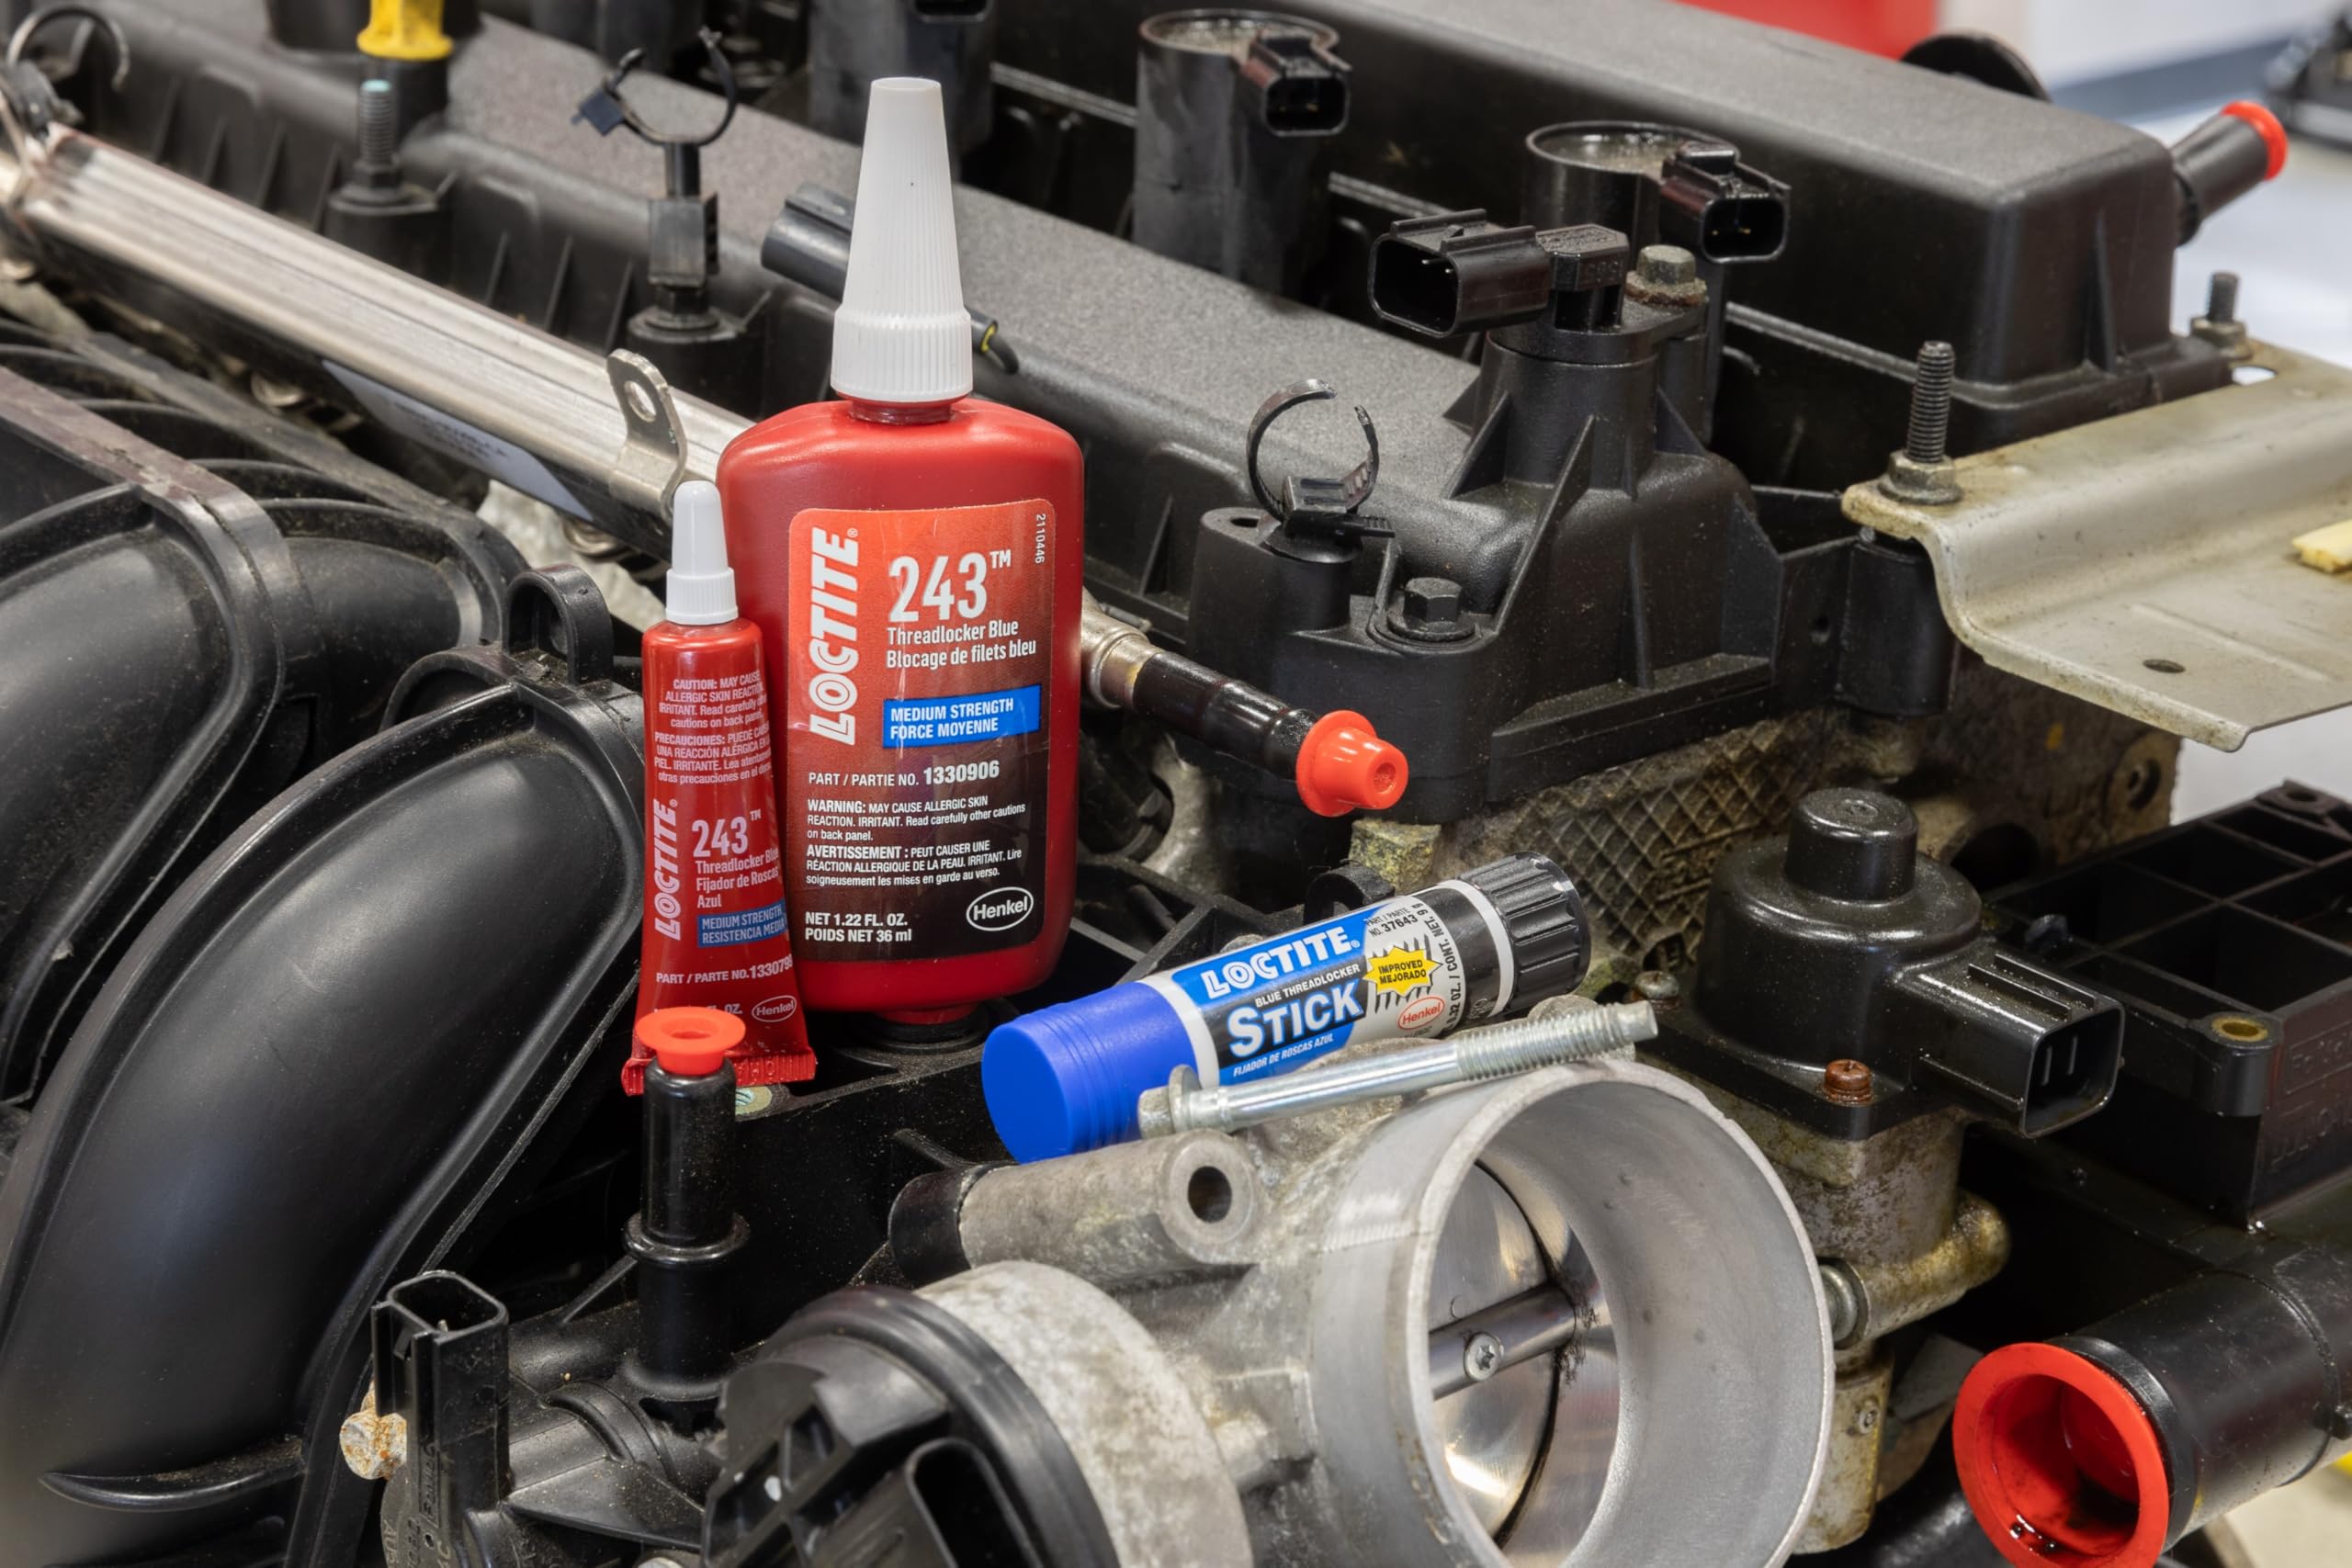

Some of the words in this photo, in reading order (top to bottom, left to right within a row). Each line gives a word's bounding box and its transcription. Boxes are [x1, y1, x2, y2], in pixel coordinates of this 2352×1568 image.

[1035, 513, 1046, 564] 2110446
[887, 626, 986, 646] Threadlocker
[989, 621, 1018, 637] Blue
[887, 648, 947, 670] Blocage
[951, 648, 967, 664] de
[971, 644, 1006, 663] filets
[1009, 639, 1036, 657] bleu
[673, 679, 717, 690] CAUTION:
[720, 676, 738, 689] MAY
[740, 670, 761, 685] CAUSE
[665, 692, 707, 703] ALLERGIC
[709, 692, 730, 702] SKIN
[659, 703, 697, 715] IRRITANT.
[700, 705, 722, 715] Read
[725, 700, 756, 714] carefully
[891, 705, 946, 722] MEDIUM
[950, 698, 1013, 718] STRENGTH
[671, 718, 707, 728] cautions
[710, 718, 721, 727] on
[724, 715, 743, 727] back
[890, 724, 933, 739] FORCE
[938, 718, 998, 736] MOYENNE
[655, 731, 725, 746] PRECAUCIONES:
[728, 729, 752, 743] PUEDE
[657, 746, 673, 756] UNA
[674, 746, 719, 758] REACCIÓN
[673, 761, 721, 771] IRRITANTE.
[724, 758, 740, 769] Lea
[808, 773, 840, 785] PART
[842, 773, 849, 785] /
[852, 773, 895, 786] PARTIE
[899, 773, 919, 785] NO.
[923, 761, 1000, 784] 1330906
[659, 773, 678, 783] otras
[680, 773, 739, 784] precauciones
[741, 771, 750, 779] en
[752, 769, 757, 777] el
[808, 799, 866, 813] WARNING:
[868, 804, 888, 813] MAY
[892, 802, 922, 812] CAUSE
[924, 797, 966, 811] ALLERGIC
[968, 795, 988, 807] SKIN
[808, 815, 855, 826] REACTION.
[858, 817, 903, 827] IRRITANT.
[906, 816, 929, 826] Read
[931, 812, 967, 826] carefully
[969, 808, 990, 820] other
[993, 804, 1025, 818] cautions
[808, 829, 818, 839] on
[821, 829, 842, 840] back
[845, 830, 873, 841] panel.
[807, 844, 901, 859] AVERTISSEMENT
[910, 847, 933, 857] PEUT
[936, 843, 970, 856] CAUSER
[973, 840, 989, 852] UNE
[695, 855, 764, 874] Threadlocker
[765, 847, 778, 863] Blue
[807, 859, 852, 873] RÉACTION
[854, 862, 910, 874] ALLERGIQUE
[913, 861, 926, 871] DE
[927, 860, 938, 870] LA
[941, 857, 966, 869] PEAU.
[968, 852, 1005, 866] IRRITANT.
[1008, 848, 1022, 860] Lire
[696, 877, 735, 894] Fijador
[737, 874, 749, 888] de
[751, 867, 778, 886] Roscas
[806, 874, 876, 886] soigneusement
[877, 875, 891, 886] les
[894, 875, 920, 886] mises
[922, 875, 933, 884] en
[936, 873, 961, 886] garde
[963, 871, 974, 880] au
[976, 867, 1000, 879] verso.
[697, 894, 722, 908] Azul
[973, 897, 1028, 920] Henkel
[702, 916, 740, 930] MEDIUM
[741, 905, 782, 926] STRENGTH
[805, 912, 831, 925] NET
[833, 913, 862, 926] 1.22
[865, 913, 884, 927] FL.
[887, 913, 908, 925] OZ.
[1386, 908, 1410, 919] PARTE
[1369, 928, 1384, 937] NO.
[1382, 914, 1418, 931] 37643
[1424, 916, 1444, 937] NET.
[703, 928, 762, 944] RESISTENCIA
[805, 929, 844, 942] POIDS
[848, 930, 873, 942] NET
[876, 930, 892, 942] 36
[896, 929, 911, 941] ml
[1439, 939, 1457, 972] CONT.
[1378, 960, 1422, 974] IMPROVED
[656, 973, 684, 984] PART
[695, 971, 729, 983] PARTE
[1255, 990, 1282, 1009] BLUE
[1283, 964, 1360, 998] THREADLOCKER
[1380, 970, 1426, 985] MEJORADO
[1452, 983, 1461, 1000] OZ.
[756, 1000, 794, 1016] Henkel
[1227, 979, 1364, 1056] STICK
[1402, 1003, 1441, 1025] Henkel
[1233, 1057, 1266, 1077] FIJADOR
[1270, 1054, 1280, 1064] DE
[1282, 1040, 1312, 1058] ROSCAS
[1315, 1033, 1334, 1047] AZUL
